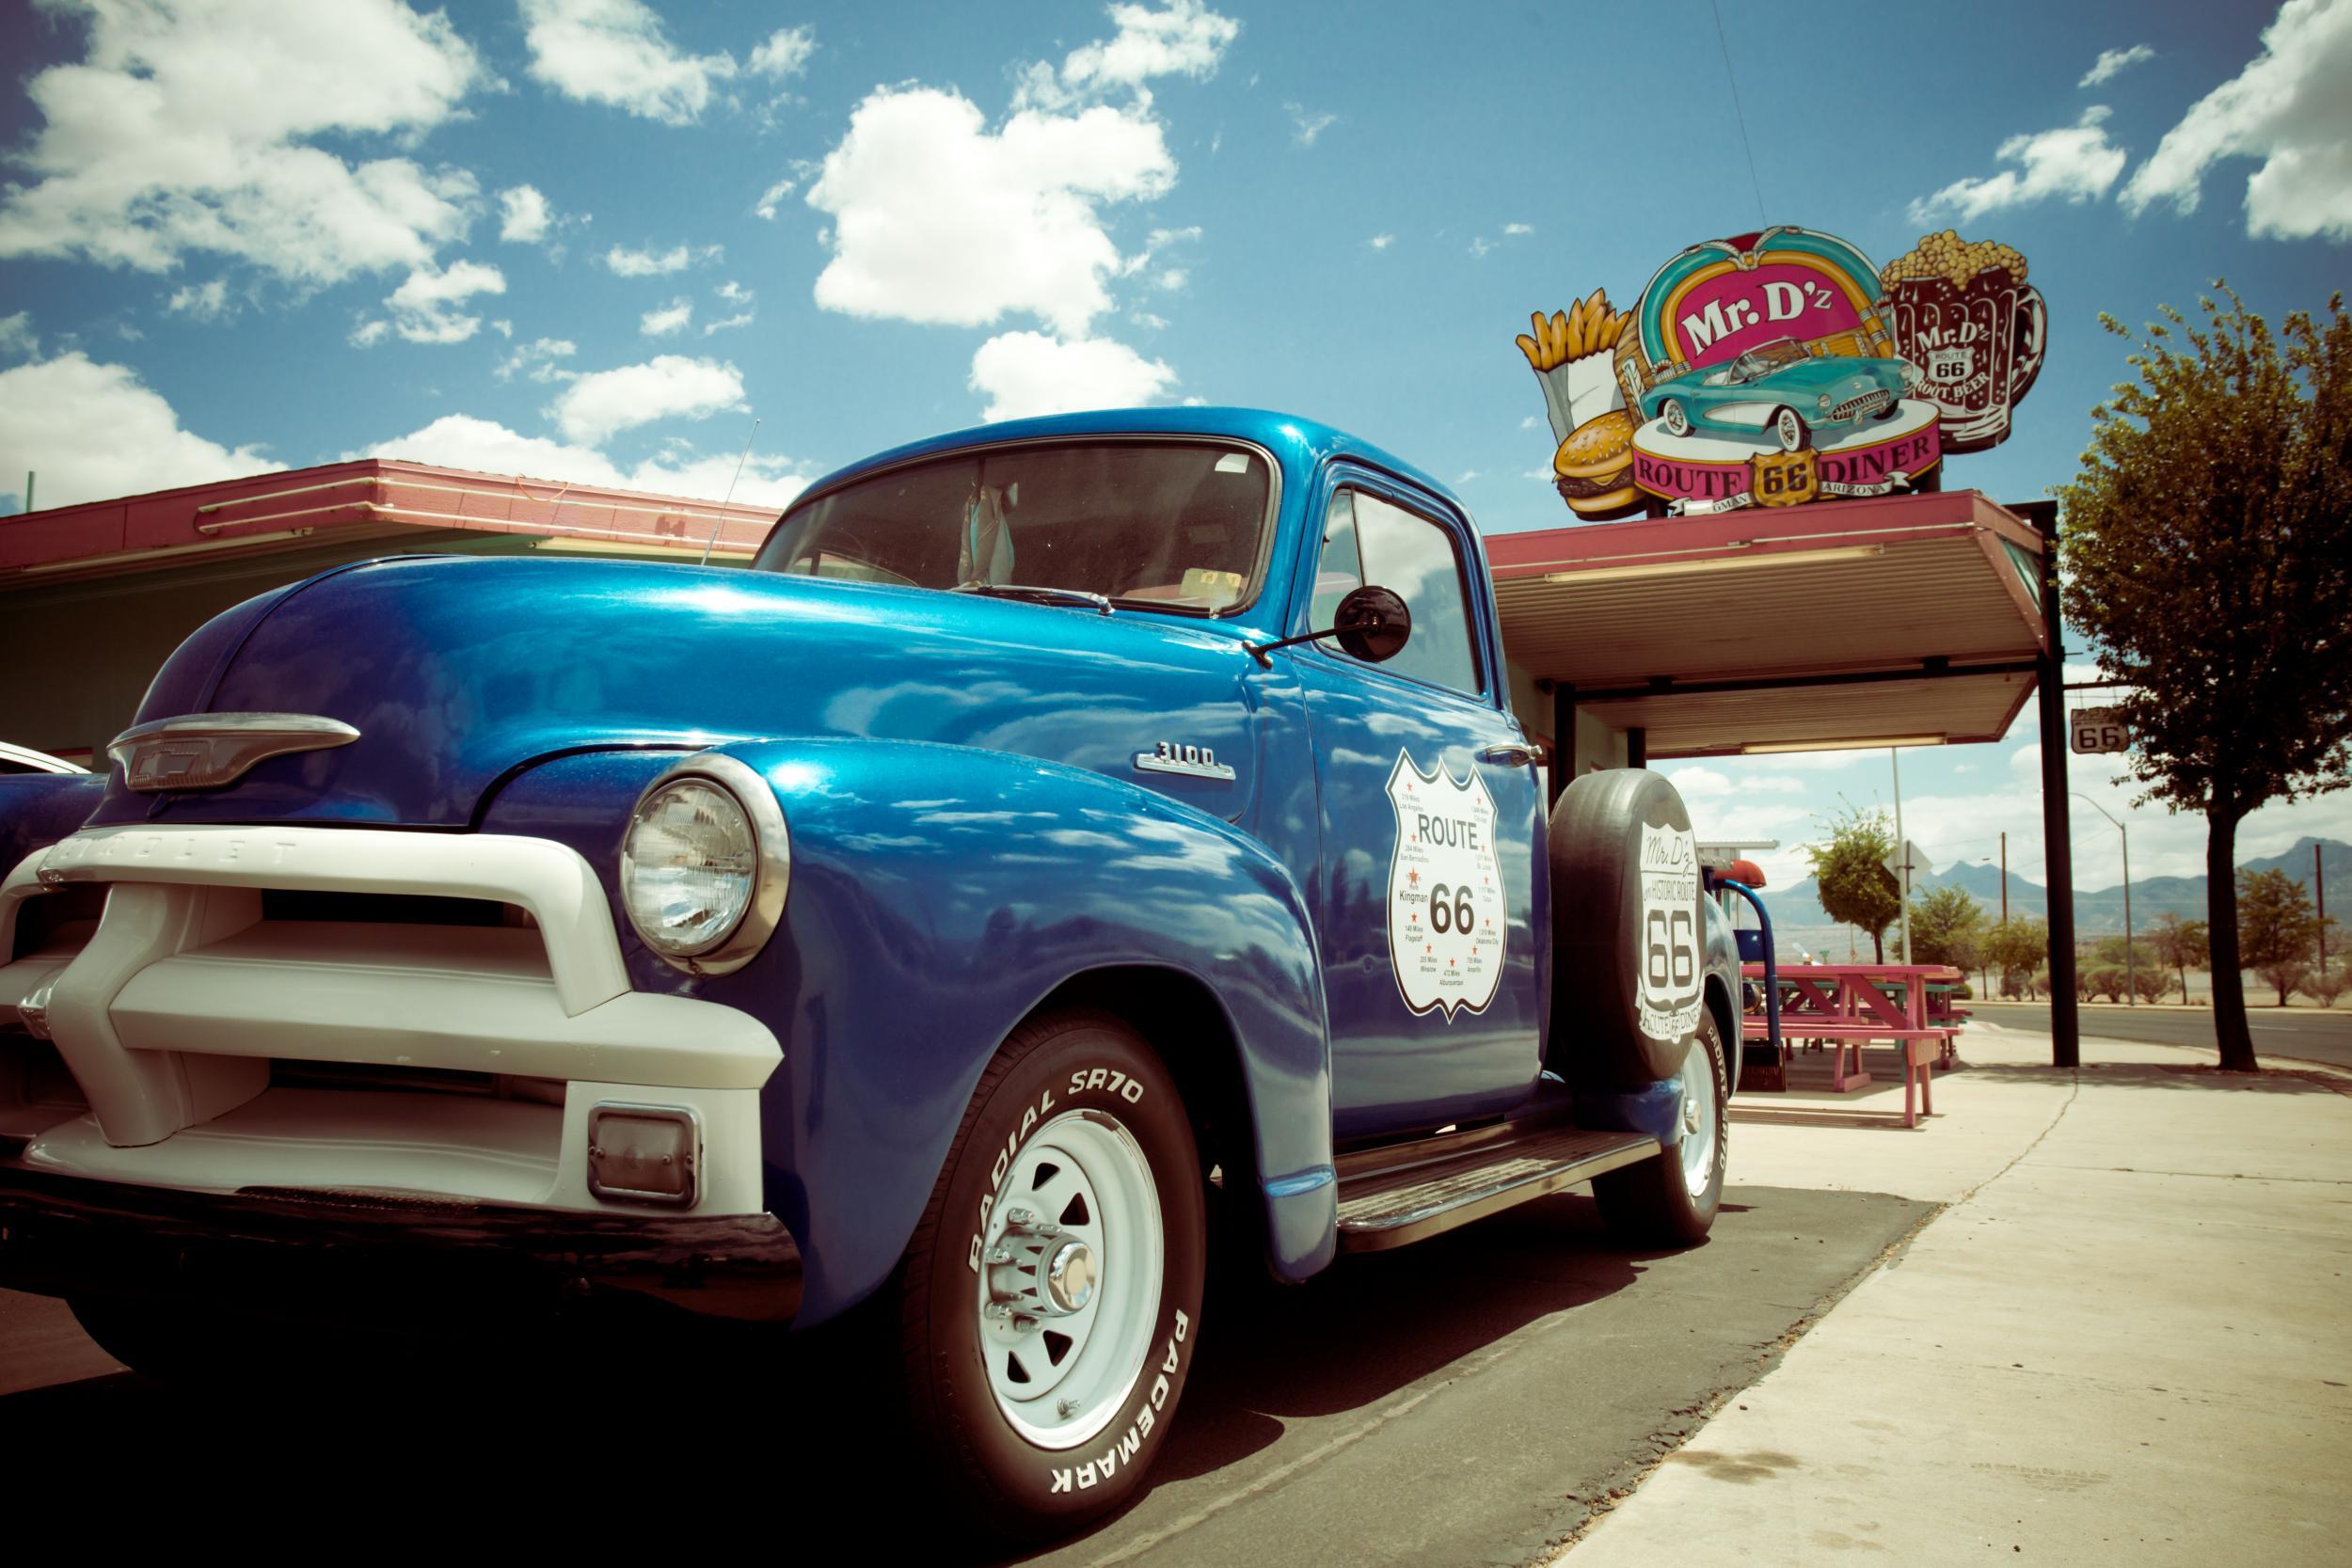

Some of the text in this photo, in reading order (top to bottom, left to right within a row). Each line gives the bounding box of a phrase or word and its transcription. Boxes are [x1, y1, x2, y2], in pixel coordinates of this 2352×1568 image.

[1680, 281, 1834, 358] Mr. D'z
[1915, 322, 1991, 352] Mr. D'z
[1935, 351, 1967, 359] ROUTE
[1936, 361, 1964, 378] 66
[1916, 372, 1990, 399] ROOT BEER
[1638, 436, 1931, 499] ROUTE 66 DINER
[1822, 483, 1886, 496] ARIZONA
[2078, 726, 2121, 750] 66
[1157, 741, 1215, 767] 3100
[1418, 814, 1479, 850] ROUTE
[1646, 835, 1669, 864] Mr.
[1399, 889, 1429, 904] Kingman
[1677, 881, 1695, 901] ROUTE
[1430, 882, 1474, 935] 66
[1647, 910, 1694, 988] 66
[1672, 1018, 1680, 1037] 66
[1708, 1025, 1728, 1098] RADIAL
[968, 1069, 1144, 1274] RADIAL SR70
[1051, 1308, 1190, 1495] PACEMARK
